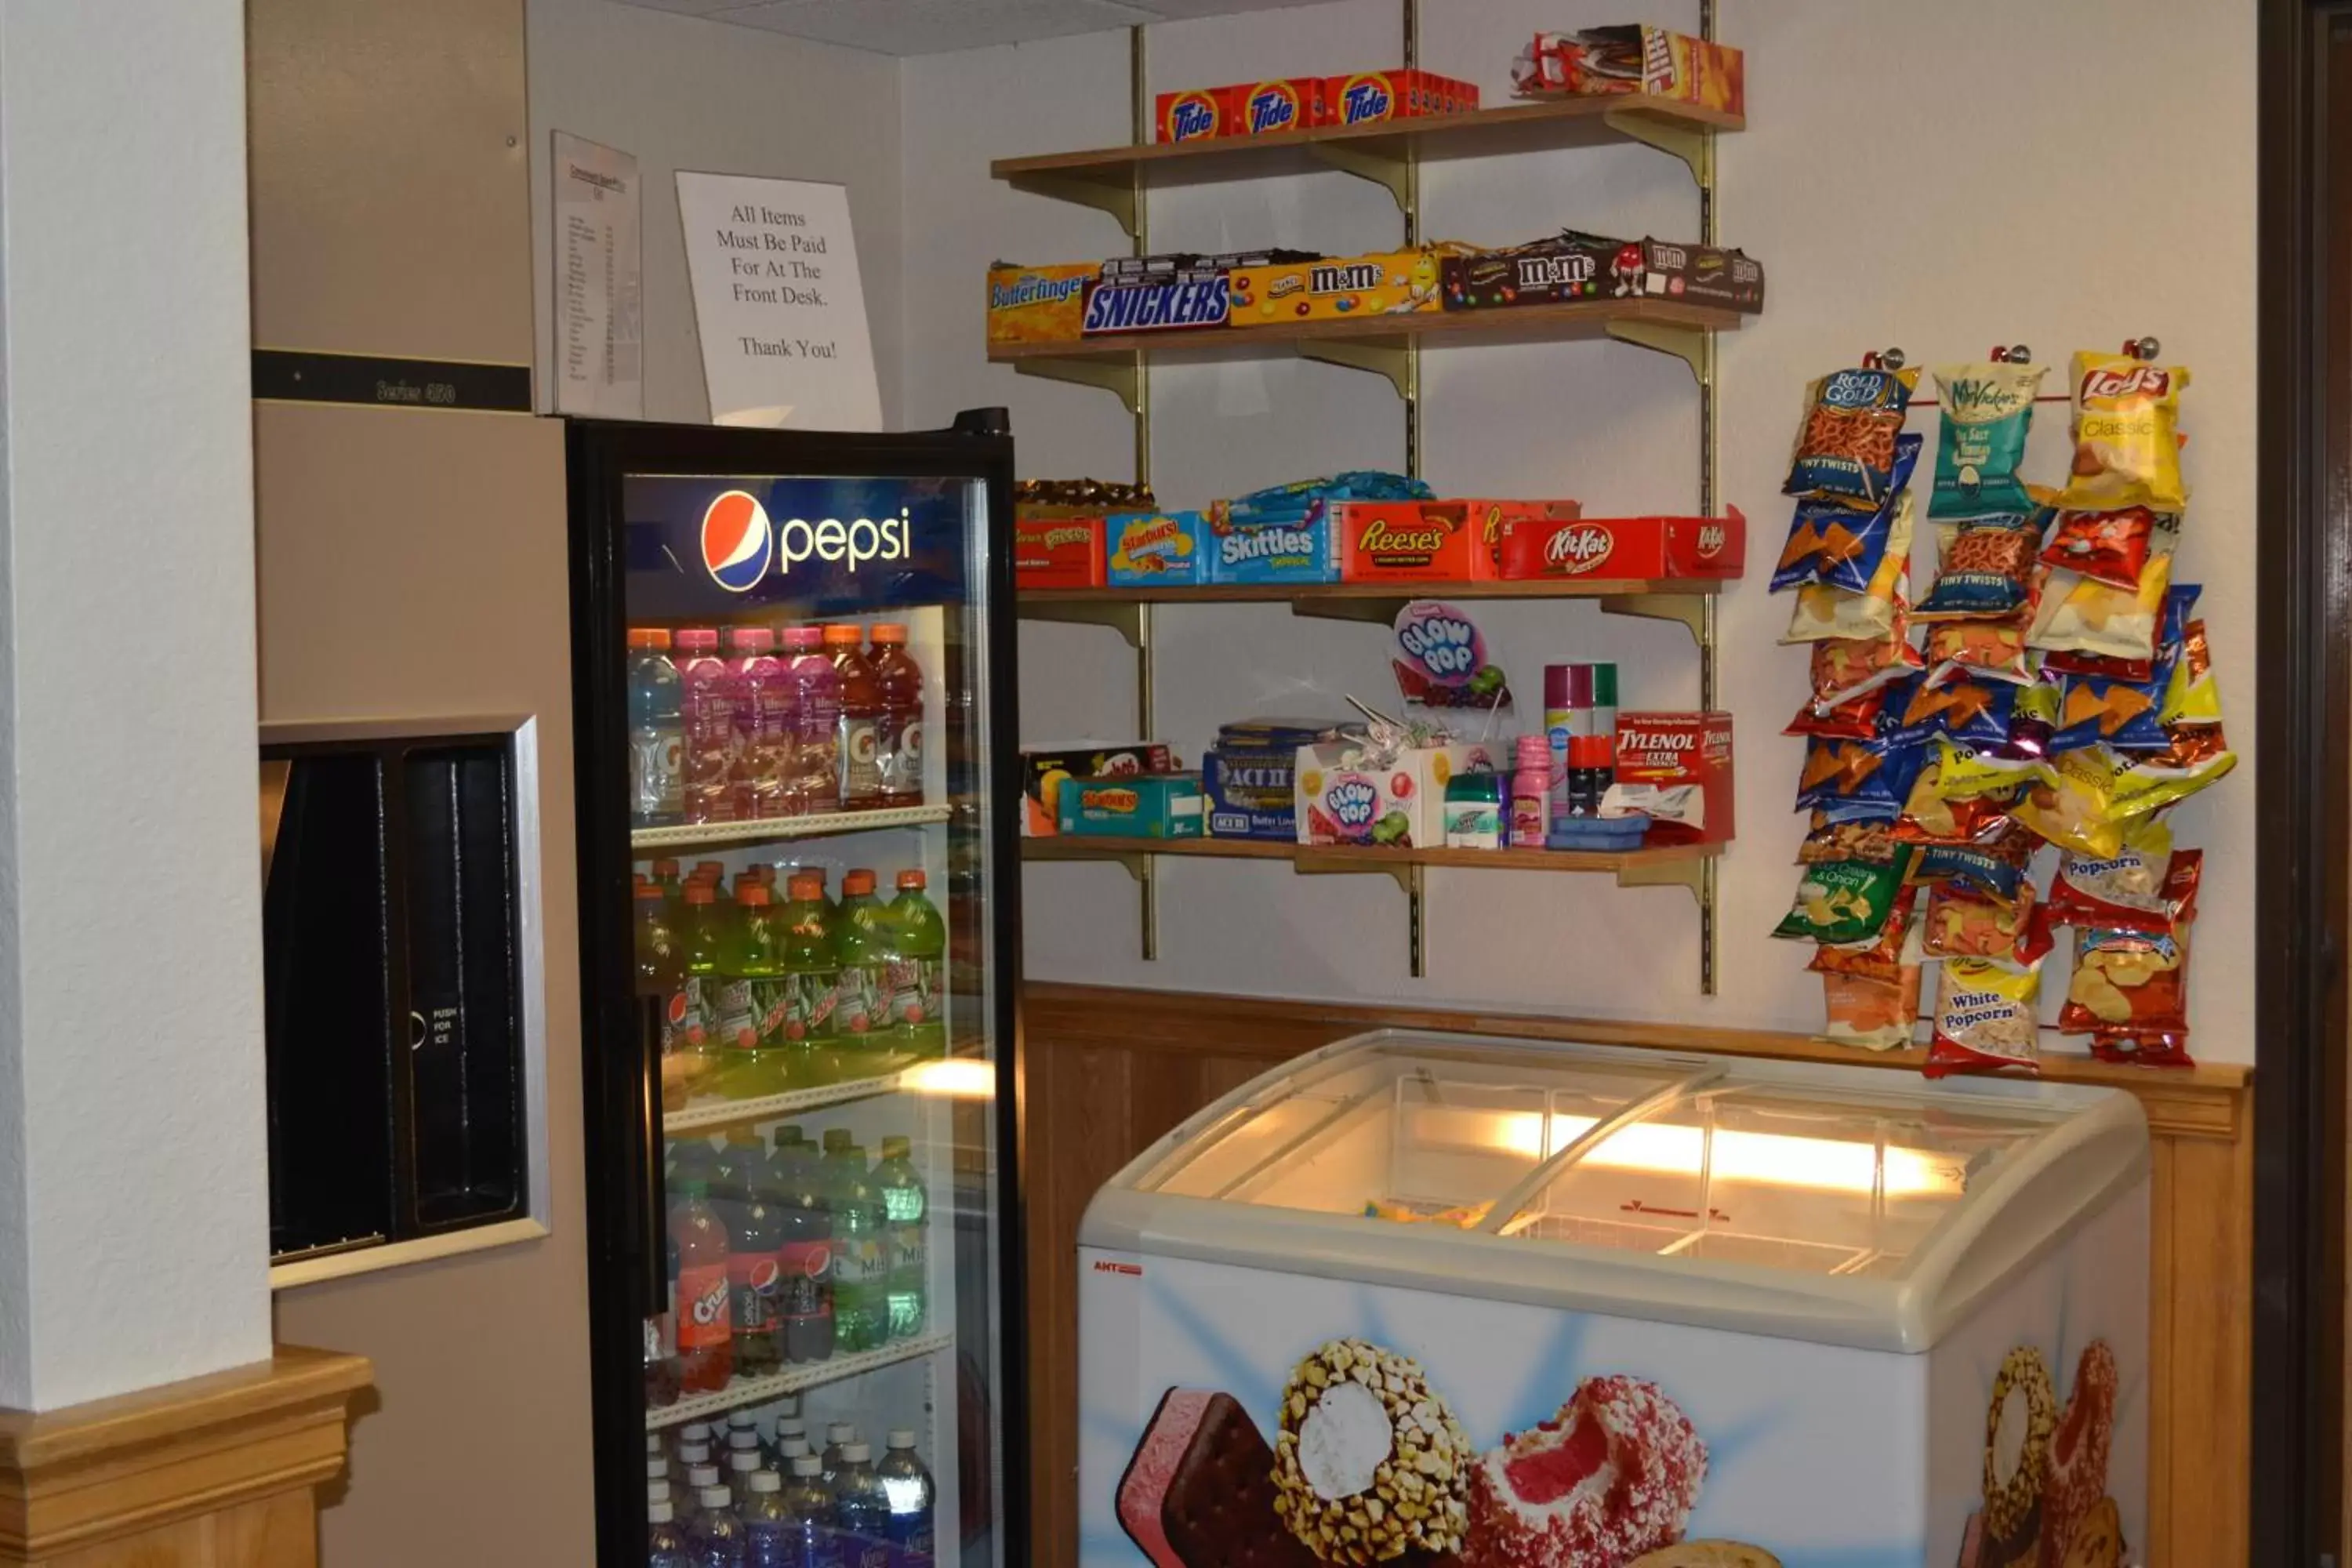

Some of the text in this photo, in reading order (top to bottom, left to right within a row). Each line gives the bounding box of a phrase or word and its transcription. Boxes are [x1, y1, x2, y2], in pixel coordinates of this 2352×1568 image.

[1252, 94, 1293, 133] Tide
[1345, 85, 1387, 125] Tide
[1174, 102, 1213, 141] Tide
[731, 205, 806, 227] All Items
[717, 230, 826, 254] Must Be Paid
[731, 257, 822, 280] For At The
[733, 283, 829, 307] Front Desk.
[991, 274, 1091, 309] Butterfinger
[1085, 278, 1229, 329] SNICKERS
[739, 336, 837, 358] Thank You!
[1837, 372, 1882, 389] ROLD
[1825, 384, 1881, 402] GOLD
[2084, 419, 2154, 438] Classic
[1821, 459, 1860, 474] TWISTS
[781, 506, 911, 574] pepsi
[1221, 528, 1314, 564] Skittles
[1359, 518, 1443, 552] Reese's
[1940, 574, 2003, 587] TINY TWISTS
[1402, 619, 1471, 655] BLOW
[1424, 645, 1473, 673] POP
[1617, 728, 1695, 751] TYLENOL
[1328, 782, 1374, 810] BLOW
[1339, 803, 1371, 824] POP
[1932, 848, 1996, 870] TINY TWISTS
[2068, 857, 2141, 876] Popcorn
[1953, 992, 2000, 1008] White
[1945, 1007, 2013, 1029] Popcorn
